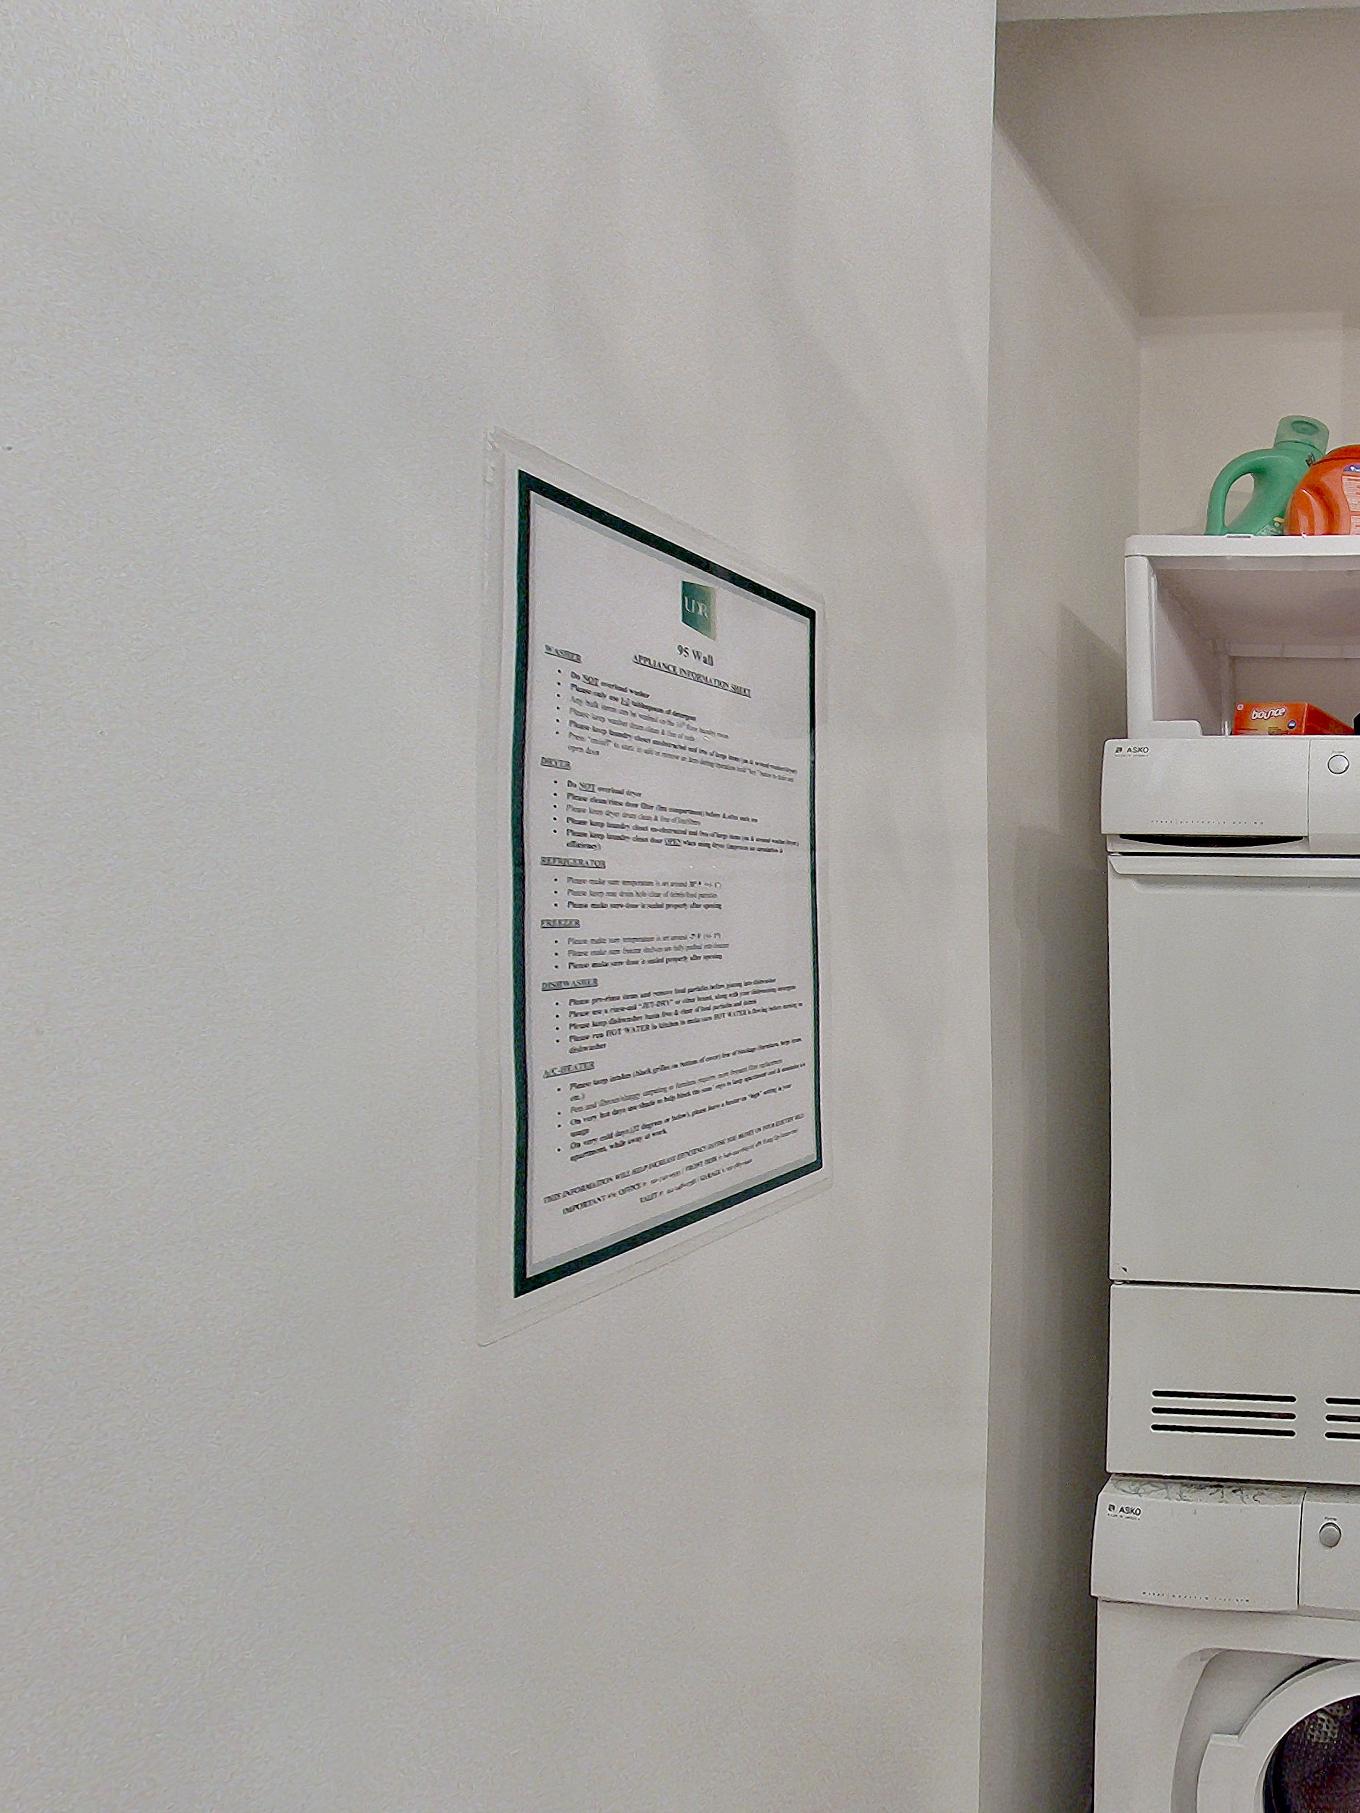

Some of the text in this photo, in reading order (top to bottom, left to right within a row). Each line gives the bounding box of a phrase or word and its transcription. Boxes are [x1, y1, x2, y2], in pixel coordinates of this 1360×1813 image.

[677, 644, 713, 666] 95 Wall
[632, 654, 677, 675] APPLIANCE
[678, 668, 729, 690] INFORMATION
[581, 674, 599, 686] NOT
[1126, 746, 1150, 754] ASKO
[578, 782, 596, 793] NOT
[540, 856, 605, 868] REFRIGERATOR
[540, 918, 580, 928] FREEZER
[541, 978, 598, 991] DISHWASHER
[1118, 1506, 1142, 1516] ASKO
